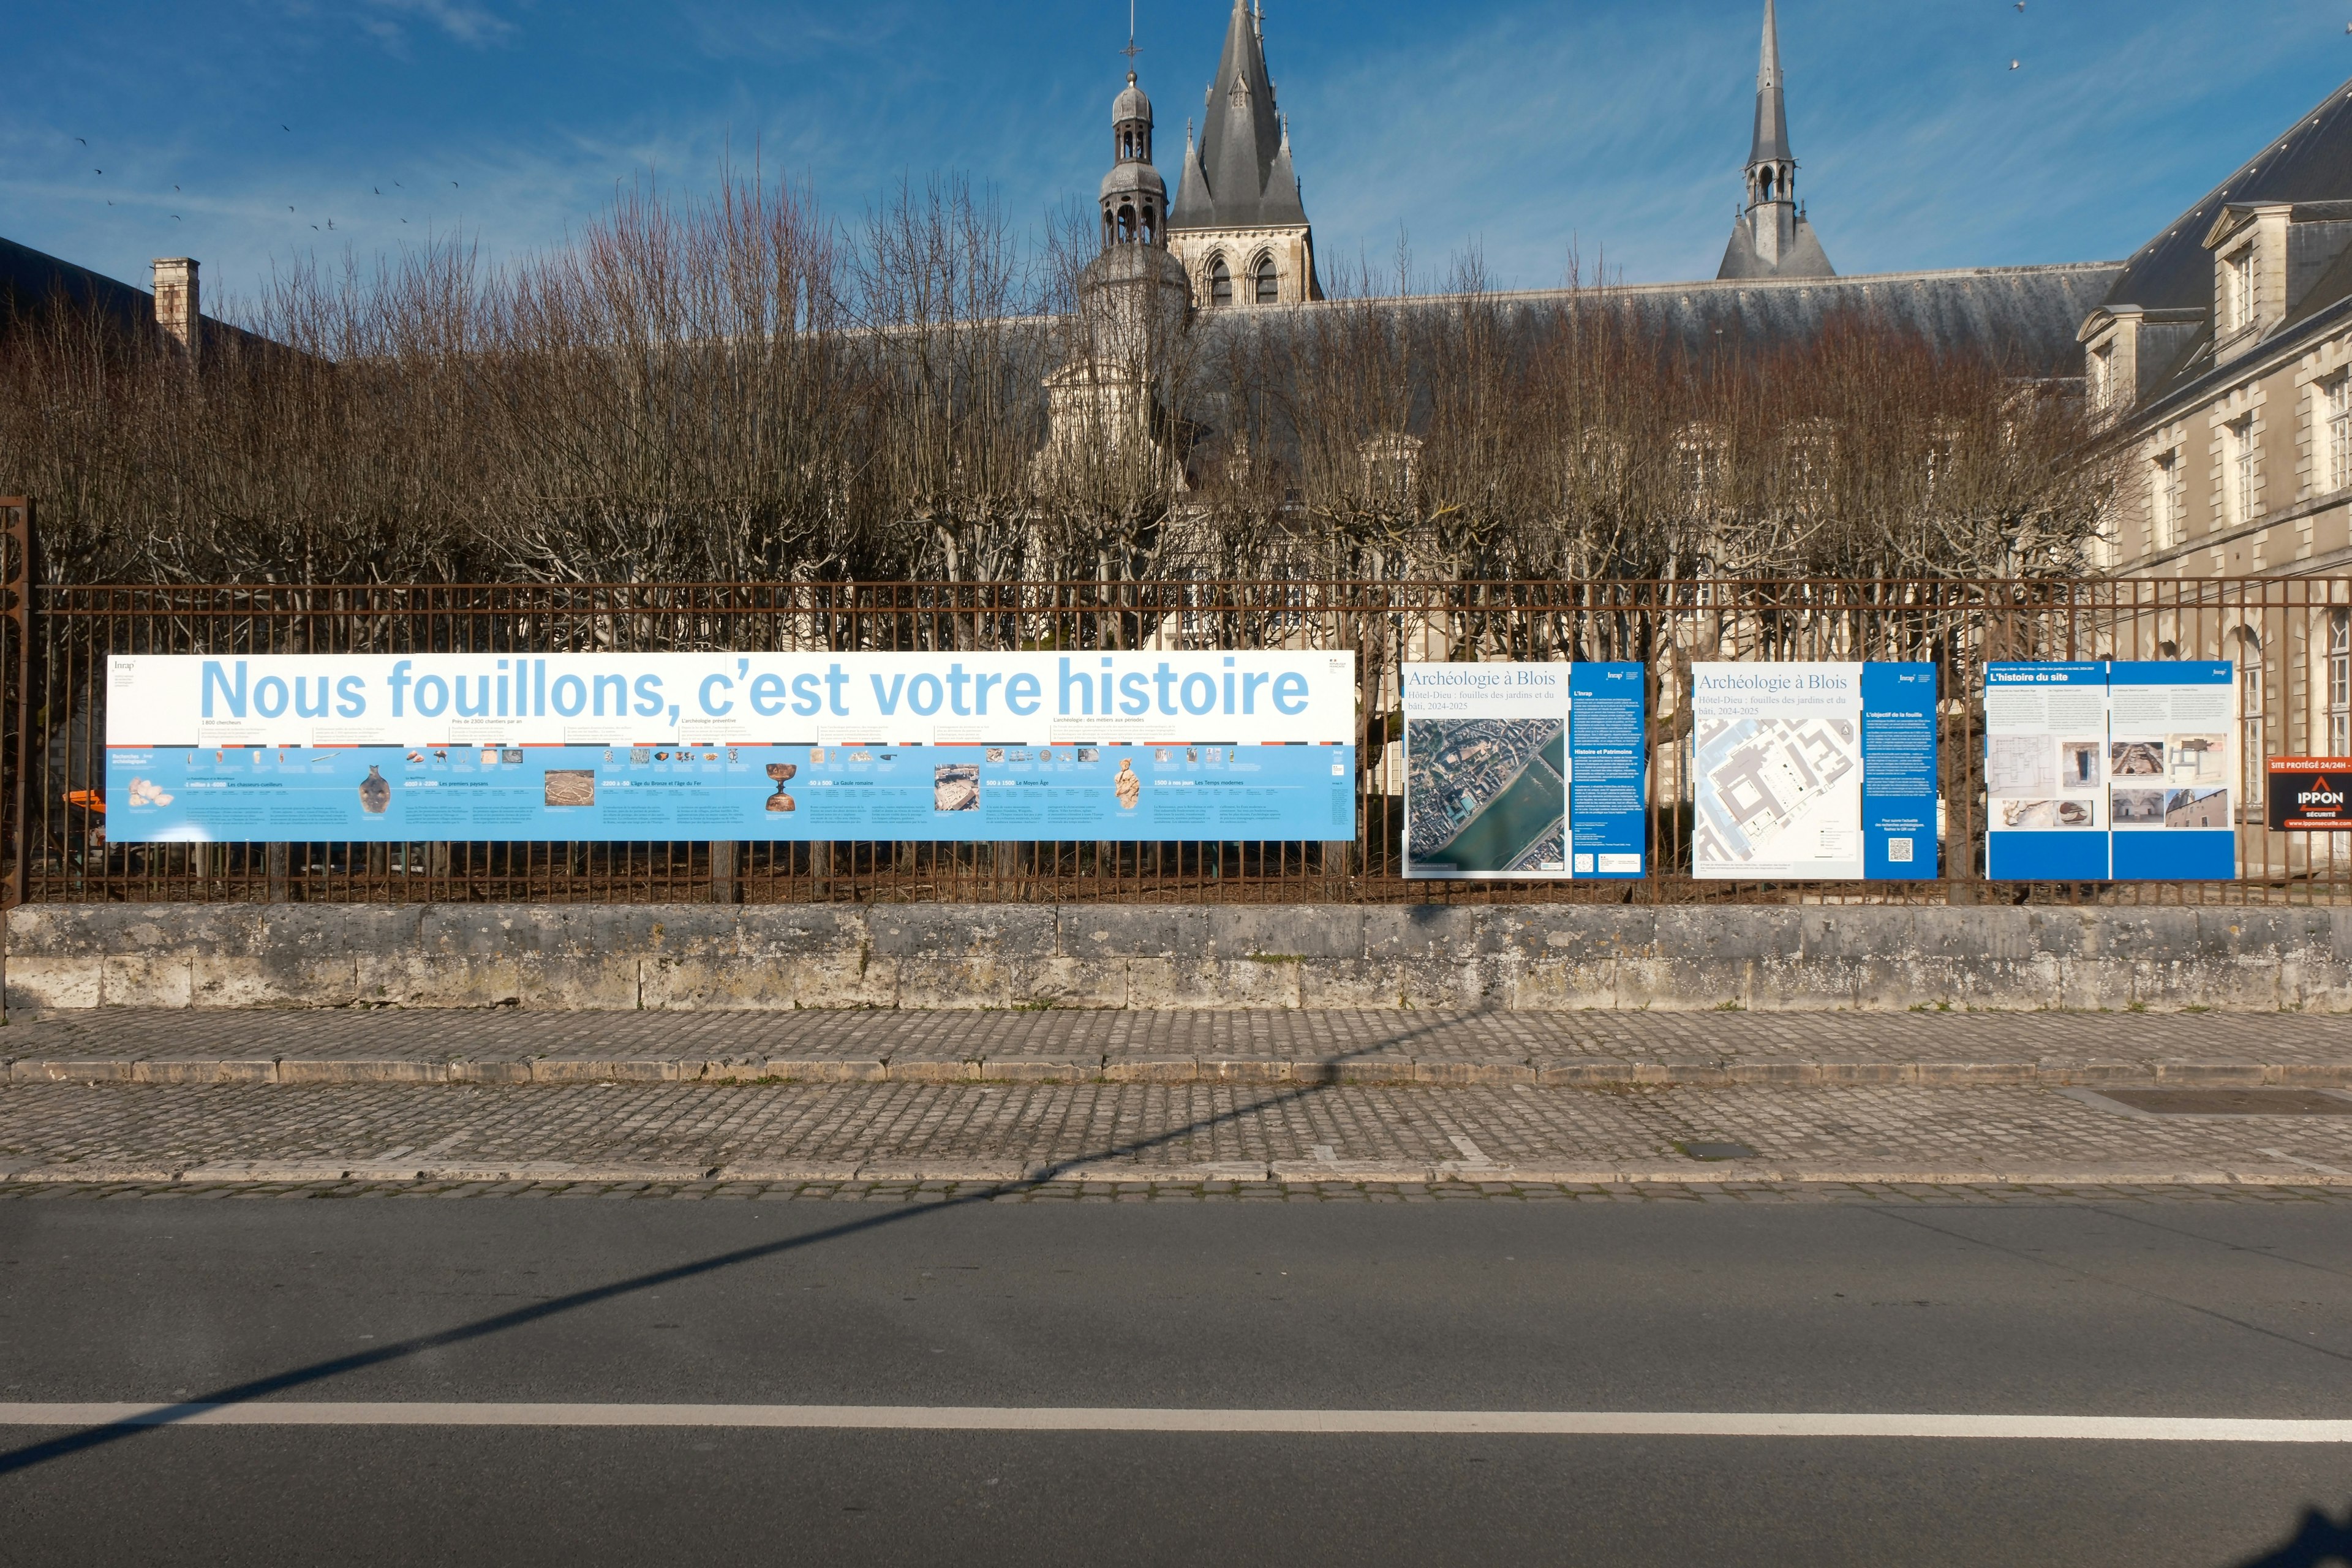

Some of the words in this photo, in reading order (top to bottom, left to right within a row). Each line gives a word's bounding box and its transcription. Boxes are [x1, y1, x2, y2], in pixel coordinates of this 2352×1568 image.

[115, 661, 134, 671] Inrap
[1409, 671, 1499, 688] Archéologie
[1504, 671, 1512, 685] à
[1517, 671, 1555, 685] Blois
[1699, 674, 1790, 692] Archéologie
[1796, 675, 1803, 688] à
[1809, 674, 1847, 688] Blois
[202, 661, 366, 718] Nous
[387, 660, 679, 727] fouillons,
[699, 658, 849, 716] c'est
[871, 664, 1041, 716] votre
[1059, 657, 1309, 715] histoire
[1506, 692, 1532, 700] jardins
[1796, 696, 1824, 705] jardins
[2298, 792, 2343, 804] IPPON
